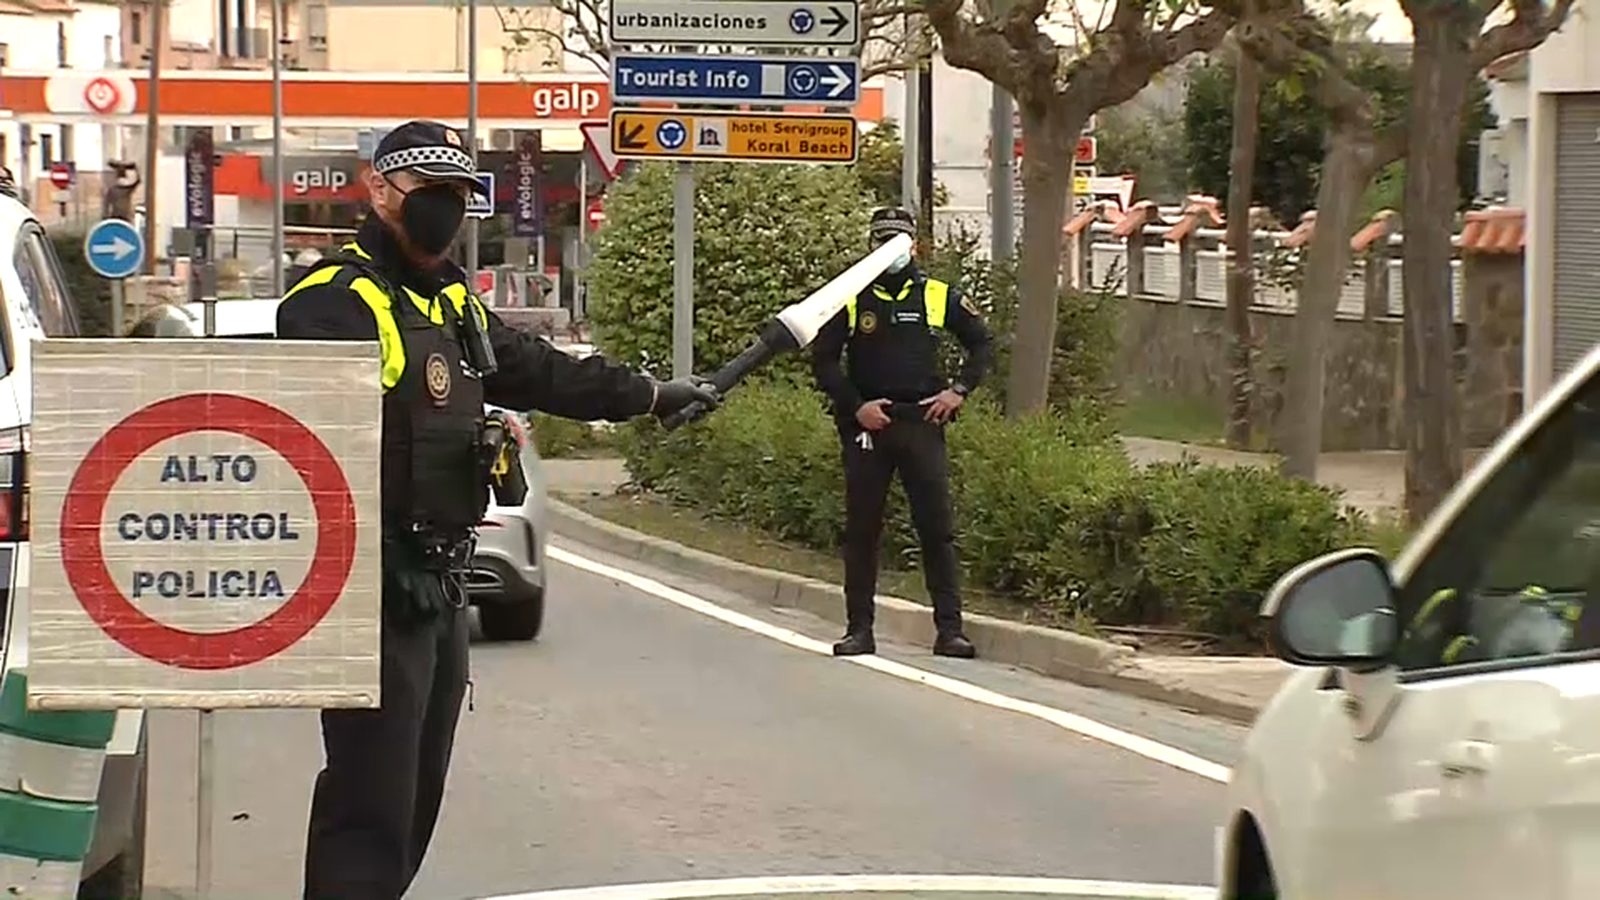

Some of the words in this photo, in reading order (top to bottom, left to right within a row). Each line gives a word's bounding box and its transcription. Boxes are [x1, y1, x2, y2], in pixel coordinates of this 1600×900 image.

[616, 13, 767, 29] urbanizaciones
[619, 68, 698, 87] Tourist
[706, 70, 750, 88] Info
[533, 83, 599, 116] galp
[732, 122, 767, 133] hotel
[774, 123, 848, 137] Servigroup
[747, 140, 790, 154] Koral
[800, 141, 848, 154] Beach
[188, 151, 206, 217] evologic
[293, 167, 347, 193] galp
[517, 152, 535, 219] evologic
[160, 455, 257, 483] ALTO
[118, 513, 299, 541] CONTROL
[132, 570, 284, 598] POLICIA
